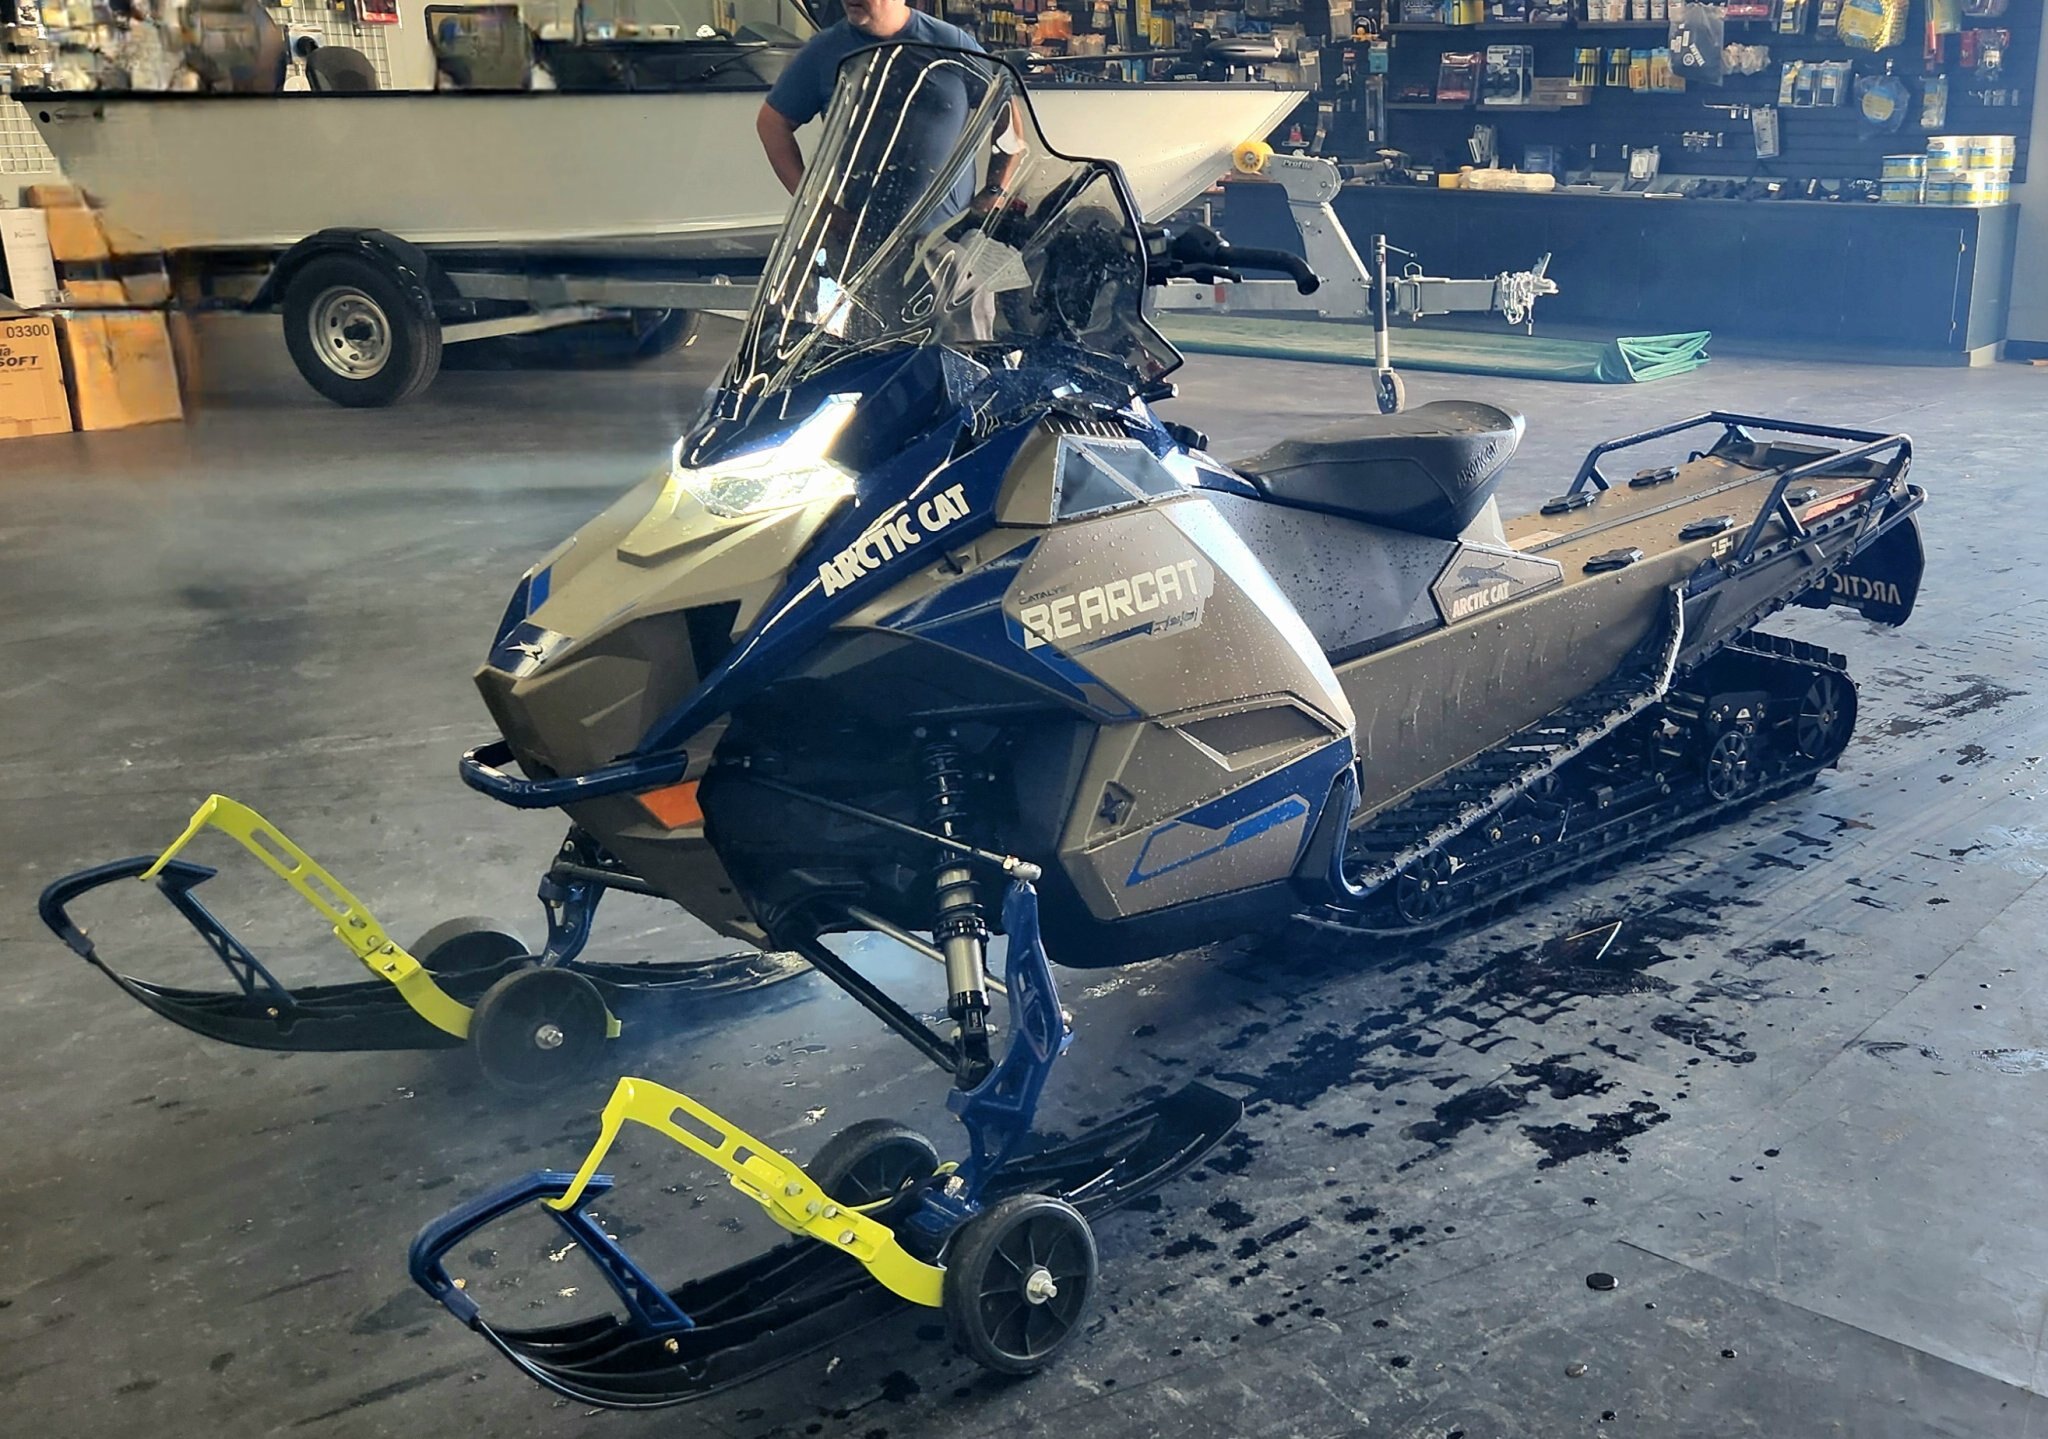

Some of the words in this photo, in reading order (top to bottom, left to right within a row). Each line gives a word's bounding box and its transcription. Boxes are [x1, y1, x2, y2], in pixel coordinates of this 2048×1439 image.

[6, 323, 50, 339] 03300
[818, 513, 922, 598] ARCTIC
[917, 482, 971, 532] CAT
[1020, 558, 1198, 650] BEARCAT
[1451, 588, 1490, 619] ARCTIC
[1490, 581, 1510, 603] CAT
